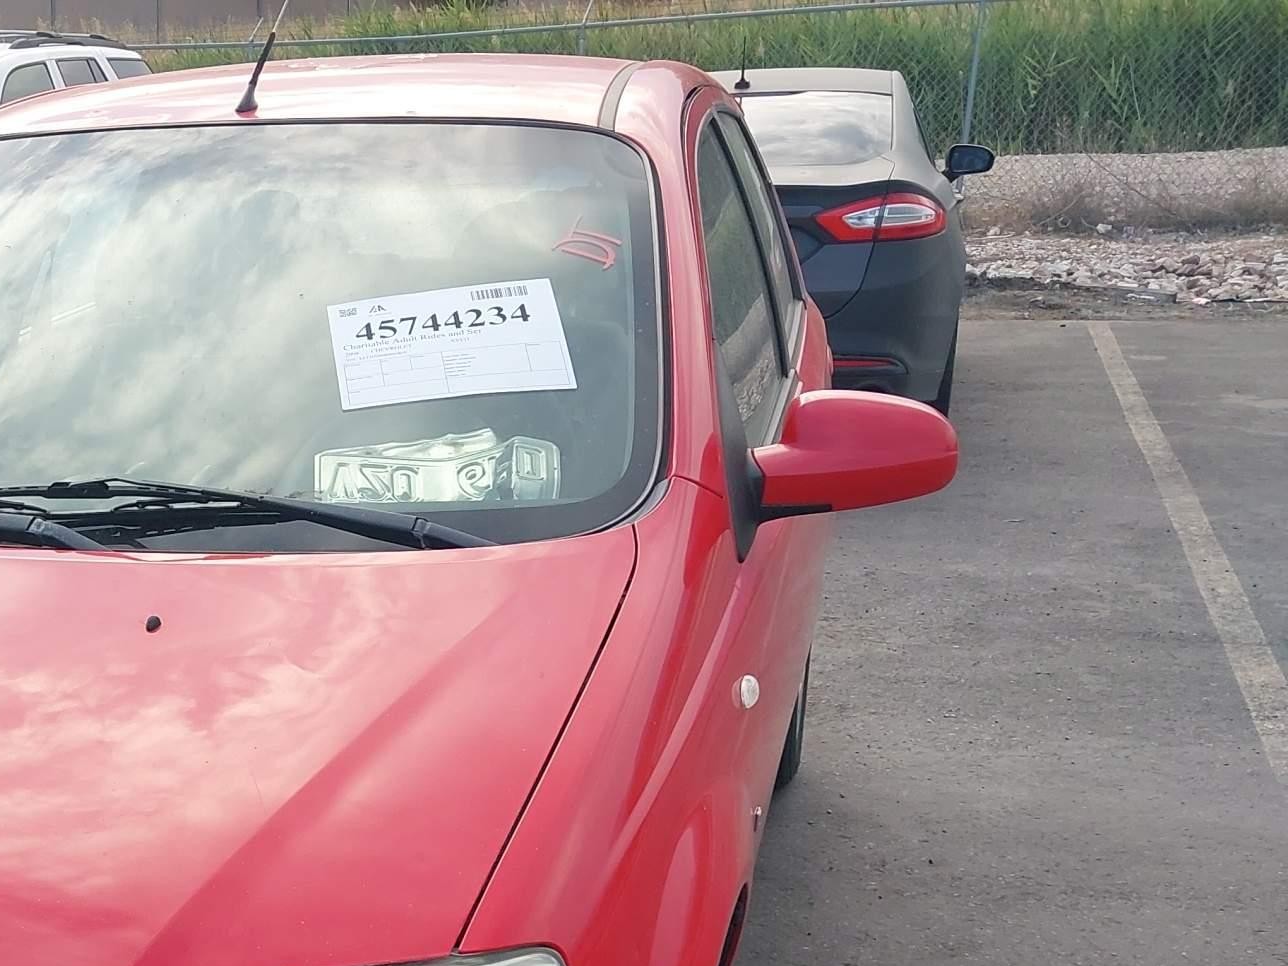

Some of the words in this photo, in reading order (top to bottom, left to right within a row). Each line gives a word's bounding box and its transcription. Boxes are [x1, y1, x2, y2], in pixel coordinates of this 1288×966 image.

[355, 303, 531, 341] 45744234
[392, 335, 417, 345] Adult
[448, 329, 464, 337] and
